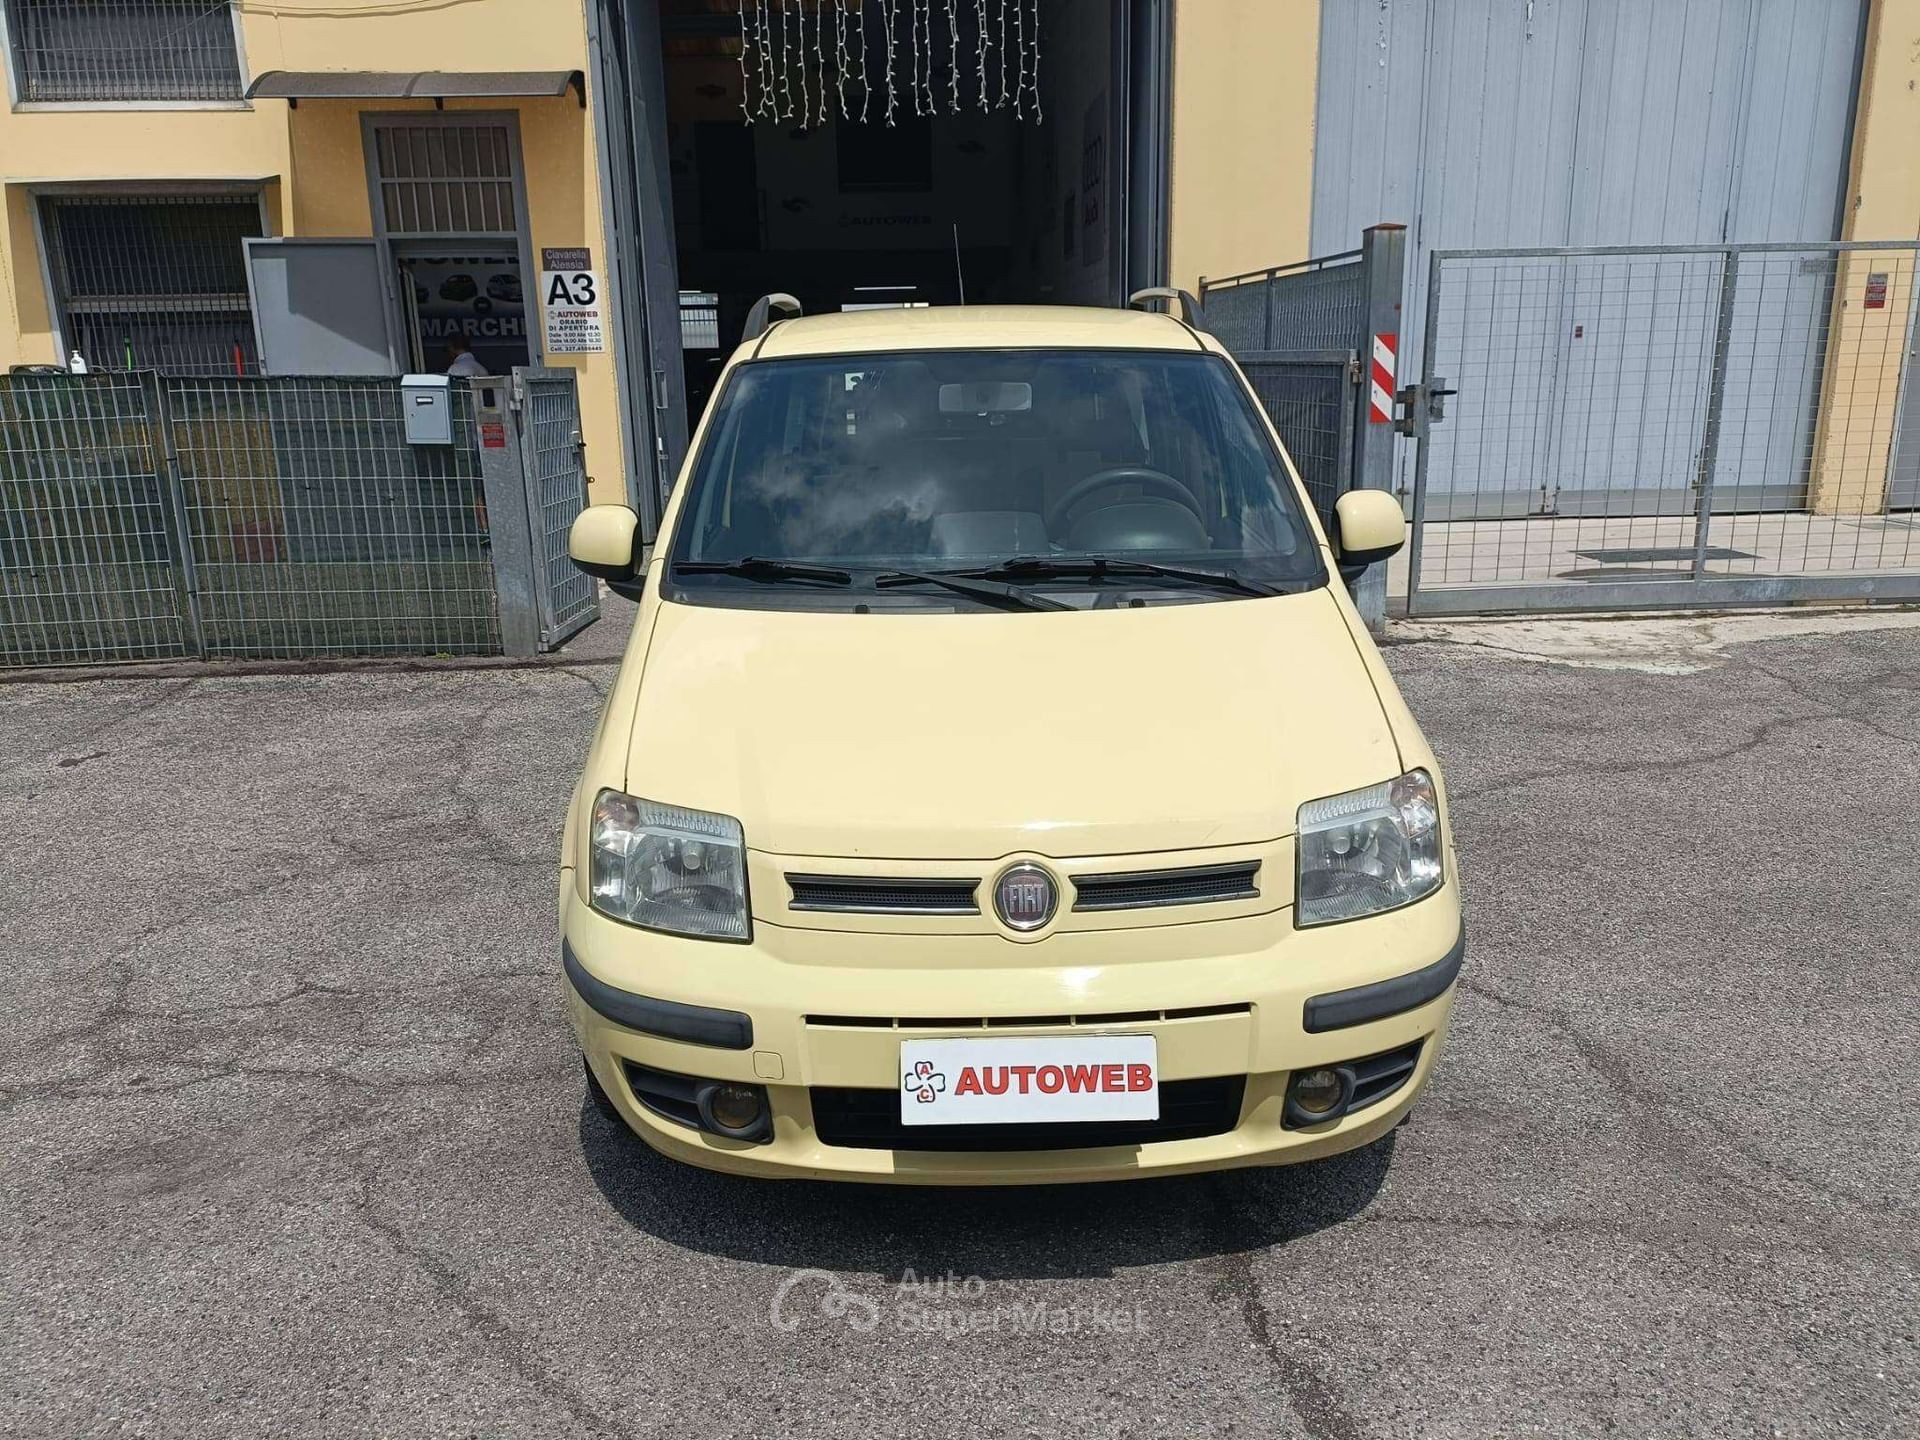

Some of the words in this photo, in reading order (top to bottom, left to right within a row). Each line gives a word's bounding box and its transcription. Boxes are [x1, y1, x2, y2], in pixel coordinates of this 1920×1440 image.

[545, 249, 587, 260] Ciavarella
[550, 260, 584, 269] Alessia
[547, 273, 596, 305] A3
[1009, 884, 1044, 913] FIAT
[954, 1063, 1153, 1096] AUTOWEB
